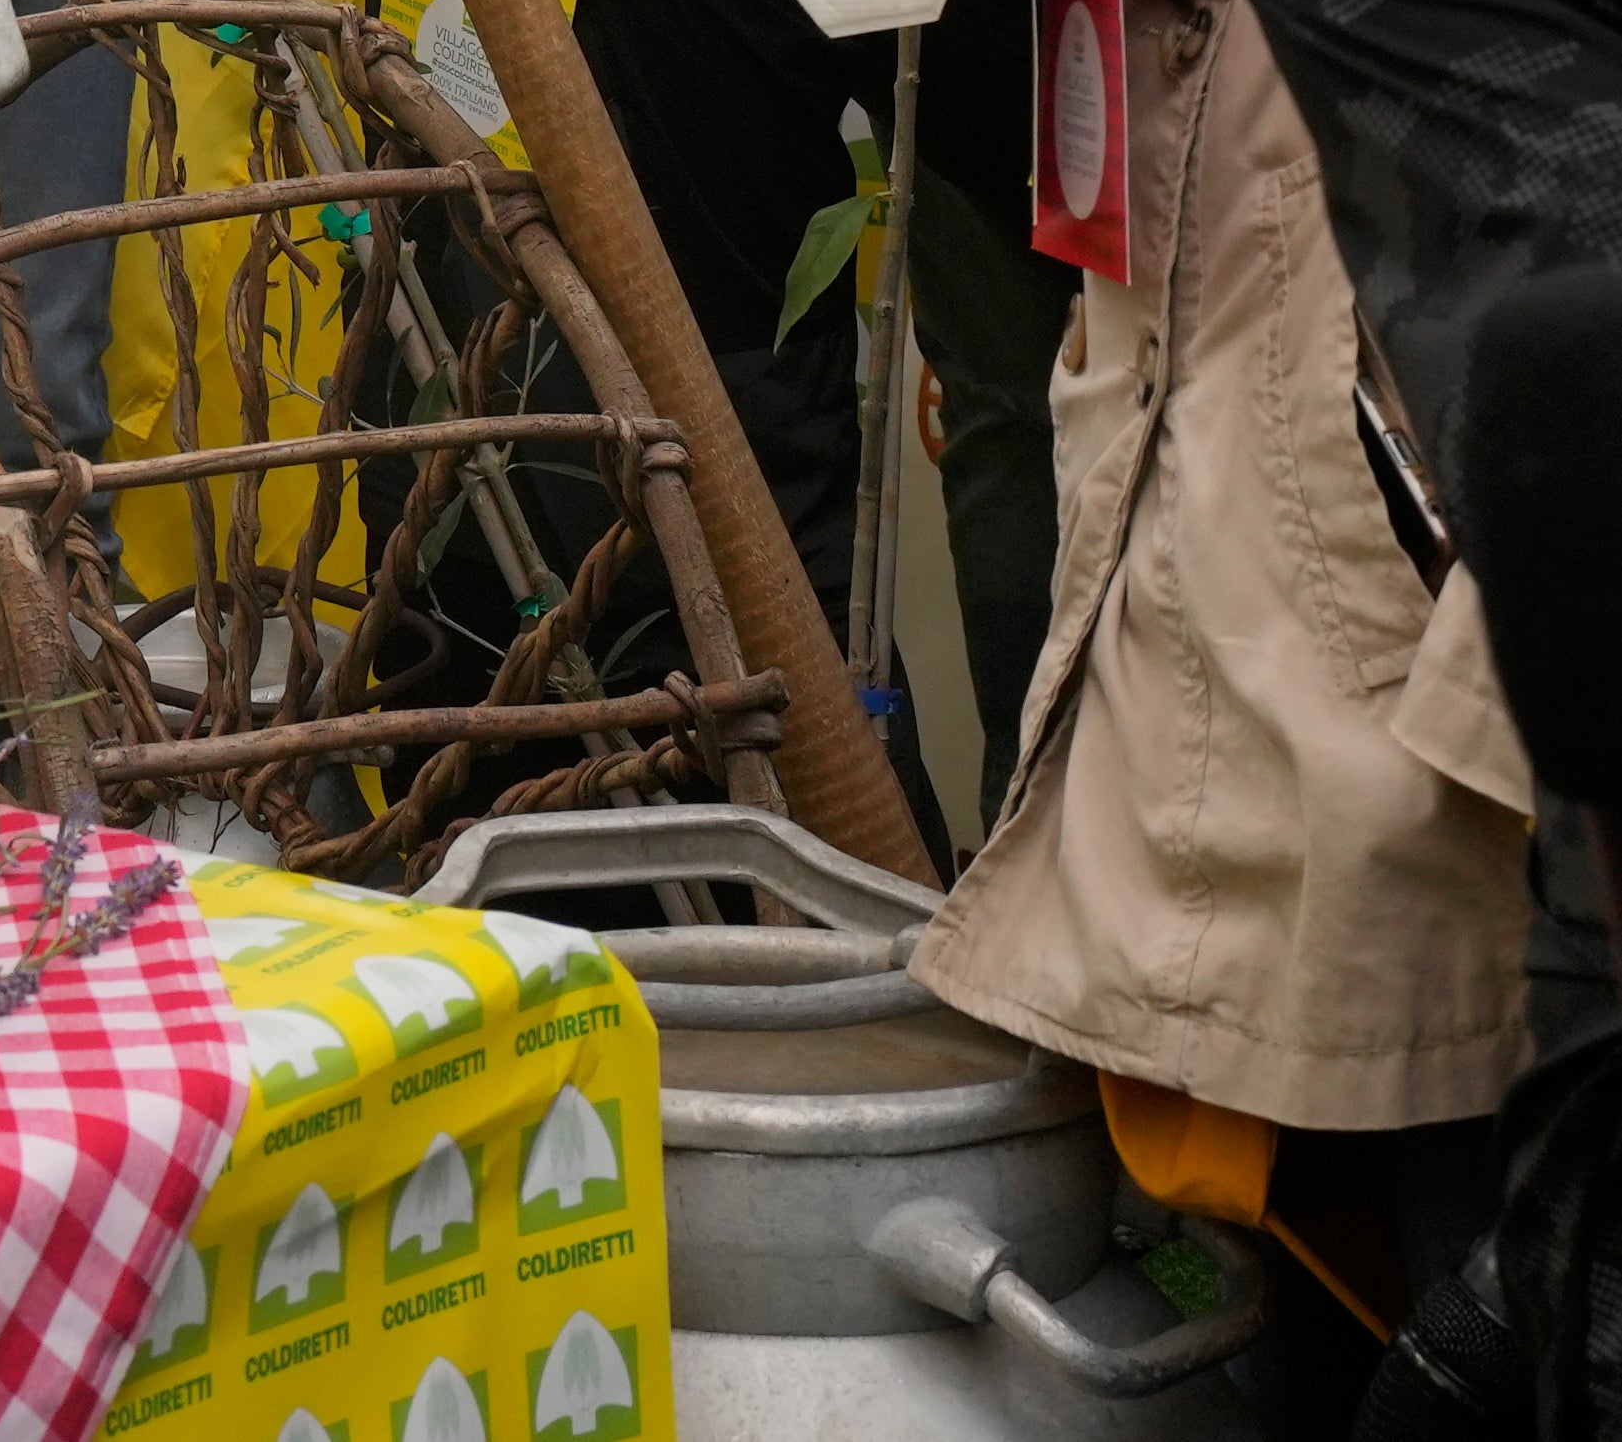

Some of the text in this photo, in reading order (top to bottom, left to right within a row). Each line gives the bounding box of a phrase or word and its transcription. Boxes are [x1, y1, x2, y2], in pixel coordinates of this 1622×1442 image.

[516, 1004, 621, 1057] COLDIRETTI
[391, 1048, 486, 1105] COLDIRETTI
[264, 1096, 362, 1156] COLDIRETTI
[518, 1230, 634, 1282] COLDIRETTI
[382, 1272, 485, 1330] COLDIRETTI
[245, 1321, 350, 1382] COLDIRETTI
[104, 1372, 214, 1440] COLDIRETTI
